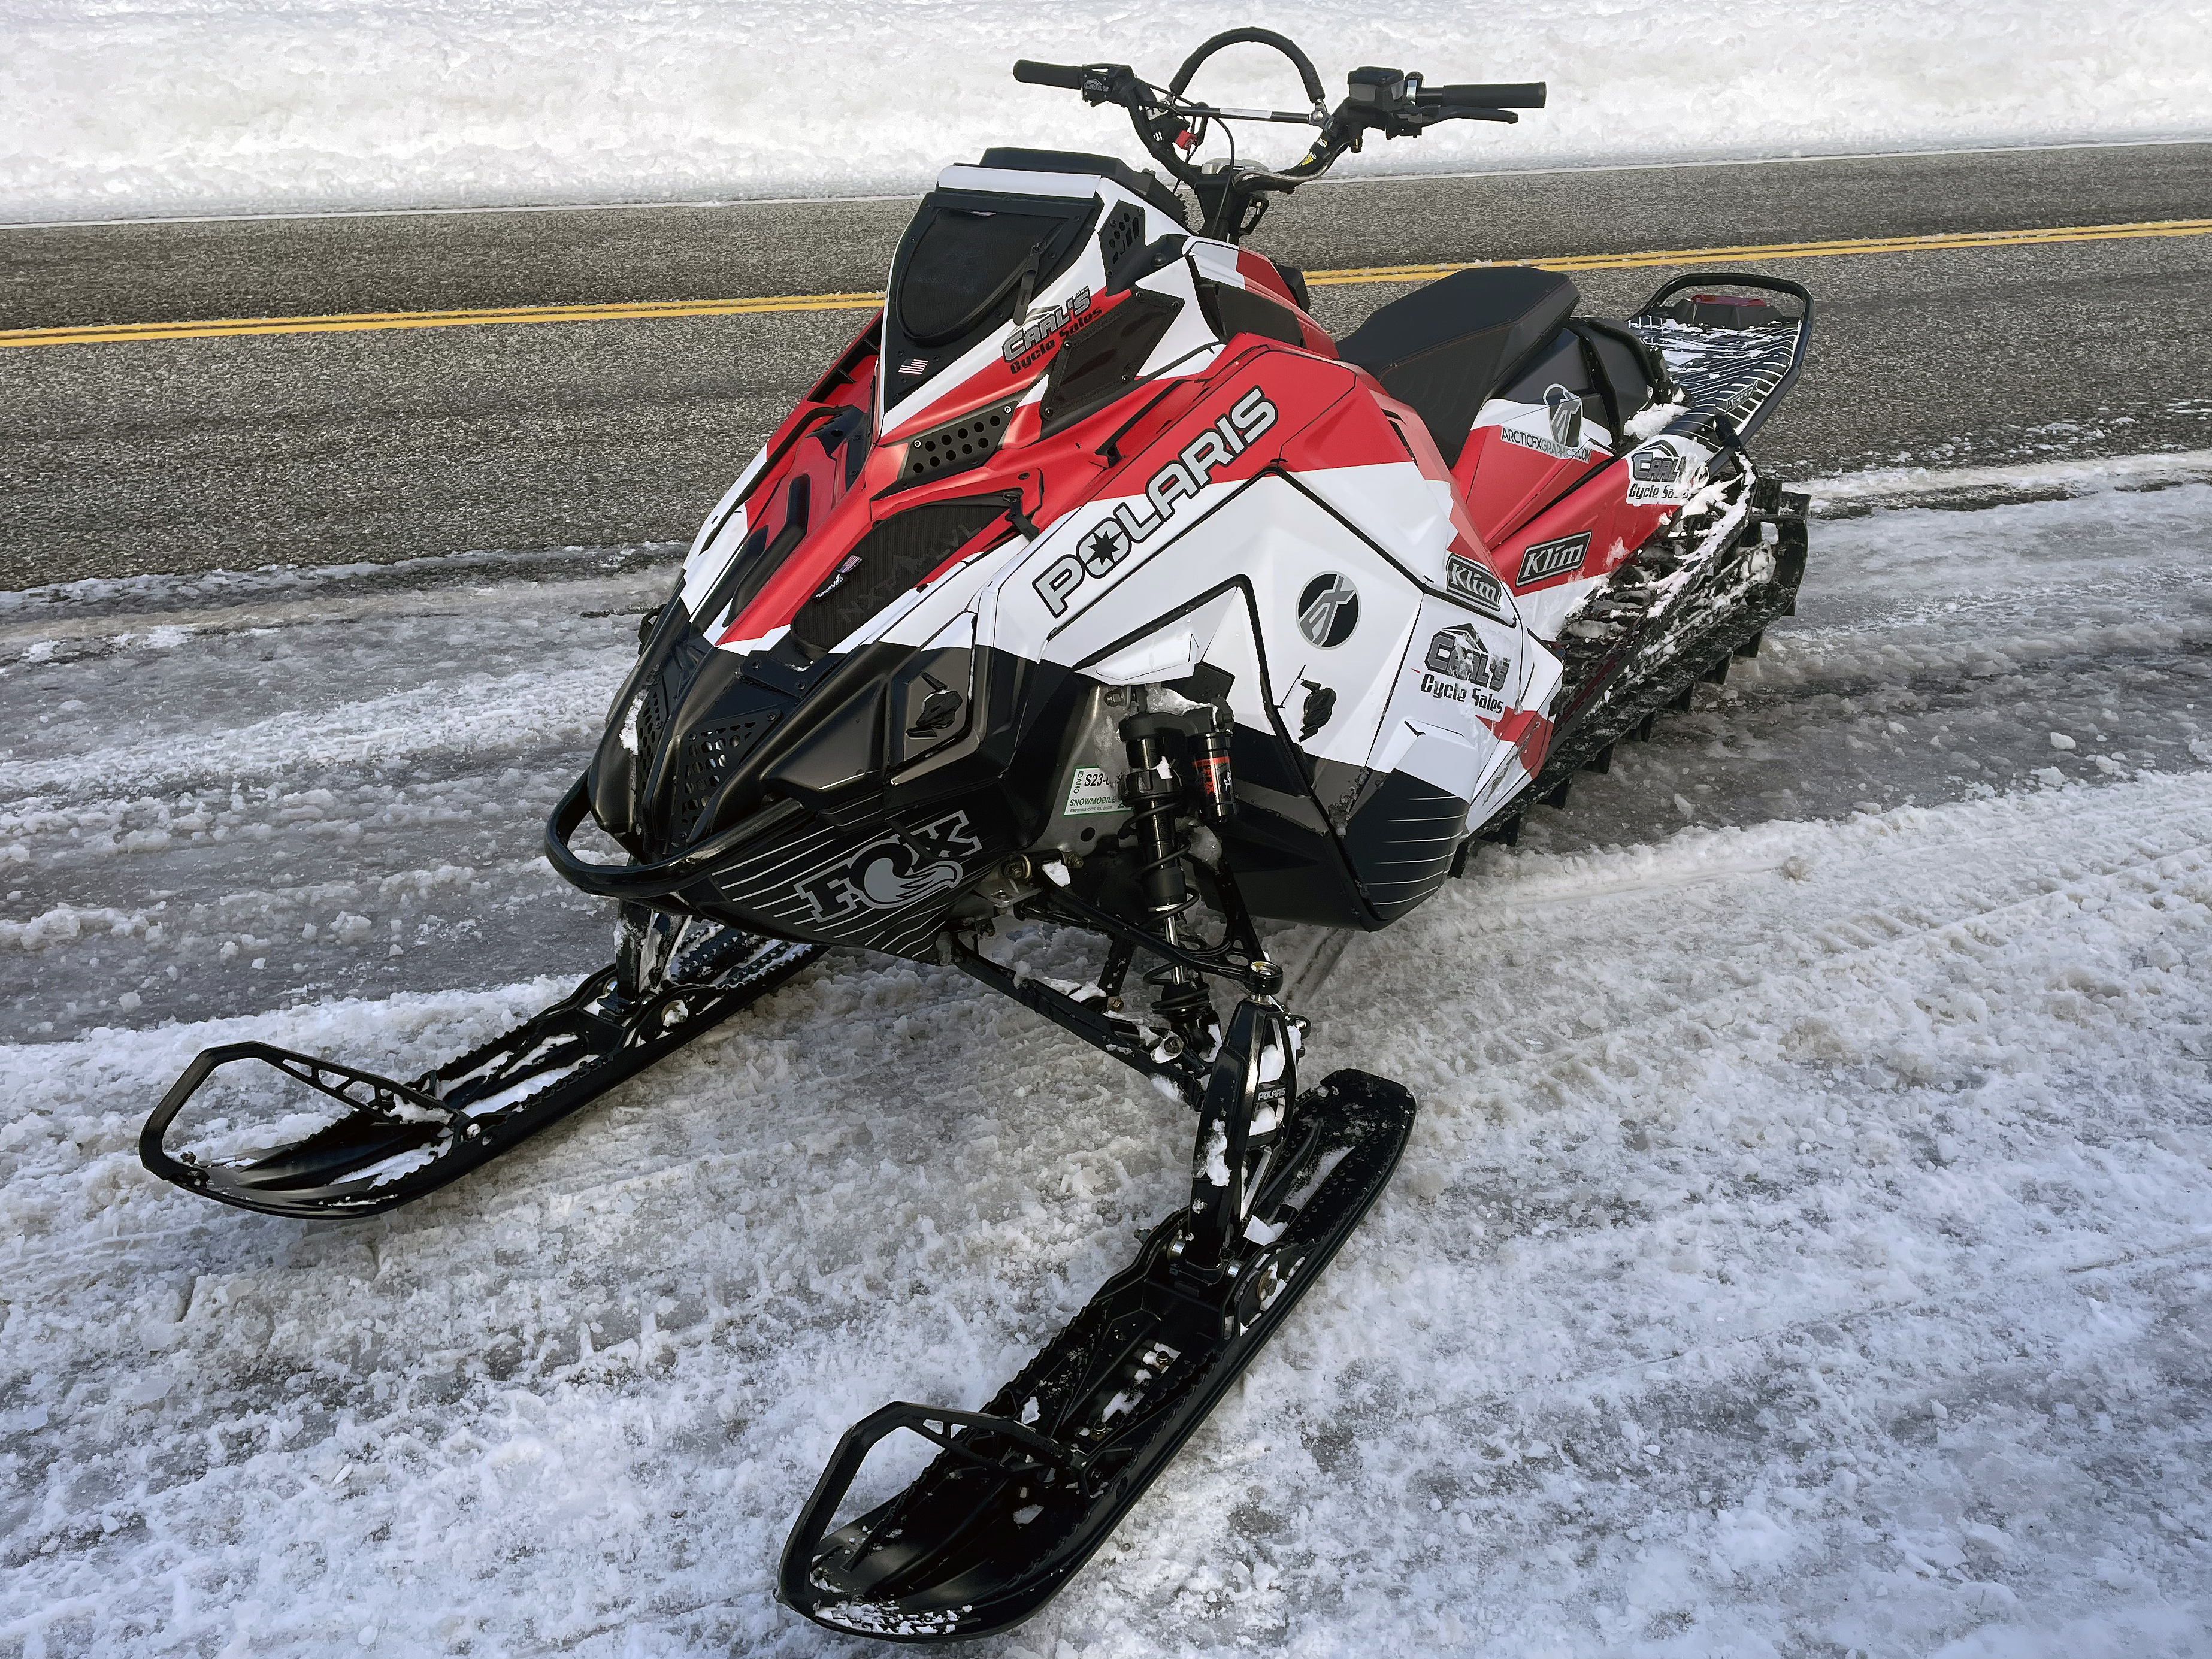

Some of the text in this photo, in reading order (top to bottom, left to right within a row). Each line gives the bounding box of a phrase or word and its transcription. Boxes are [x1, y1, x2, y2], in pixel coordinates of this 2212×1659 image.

[1002, 287, 1091, 363] CARL'S
[1010, 306, 1103, 374] Cycle Sales
[1032, 385, 1278, 619] POLARIS
[1629, 483, 1659, 499] Cycle
[1522, 544, 1584, 579] Klim
[1451, 562, 1497, 602] Klim
[1420, 673, 1504, 714] Cycle Sales
[1070, 796, 1116, 807] SNOWMOBILE
[1073, 771, 1084, 794] IDAHO
